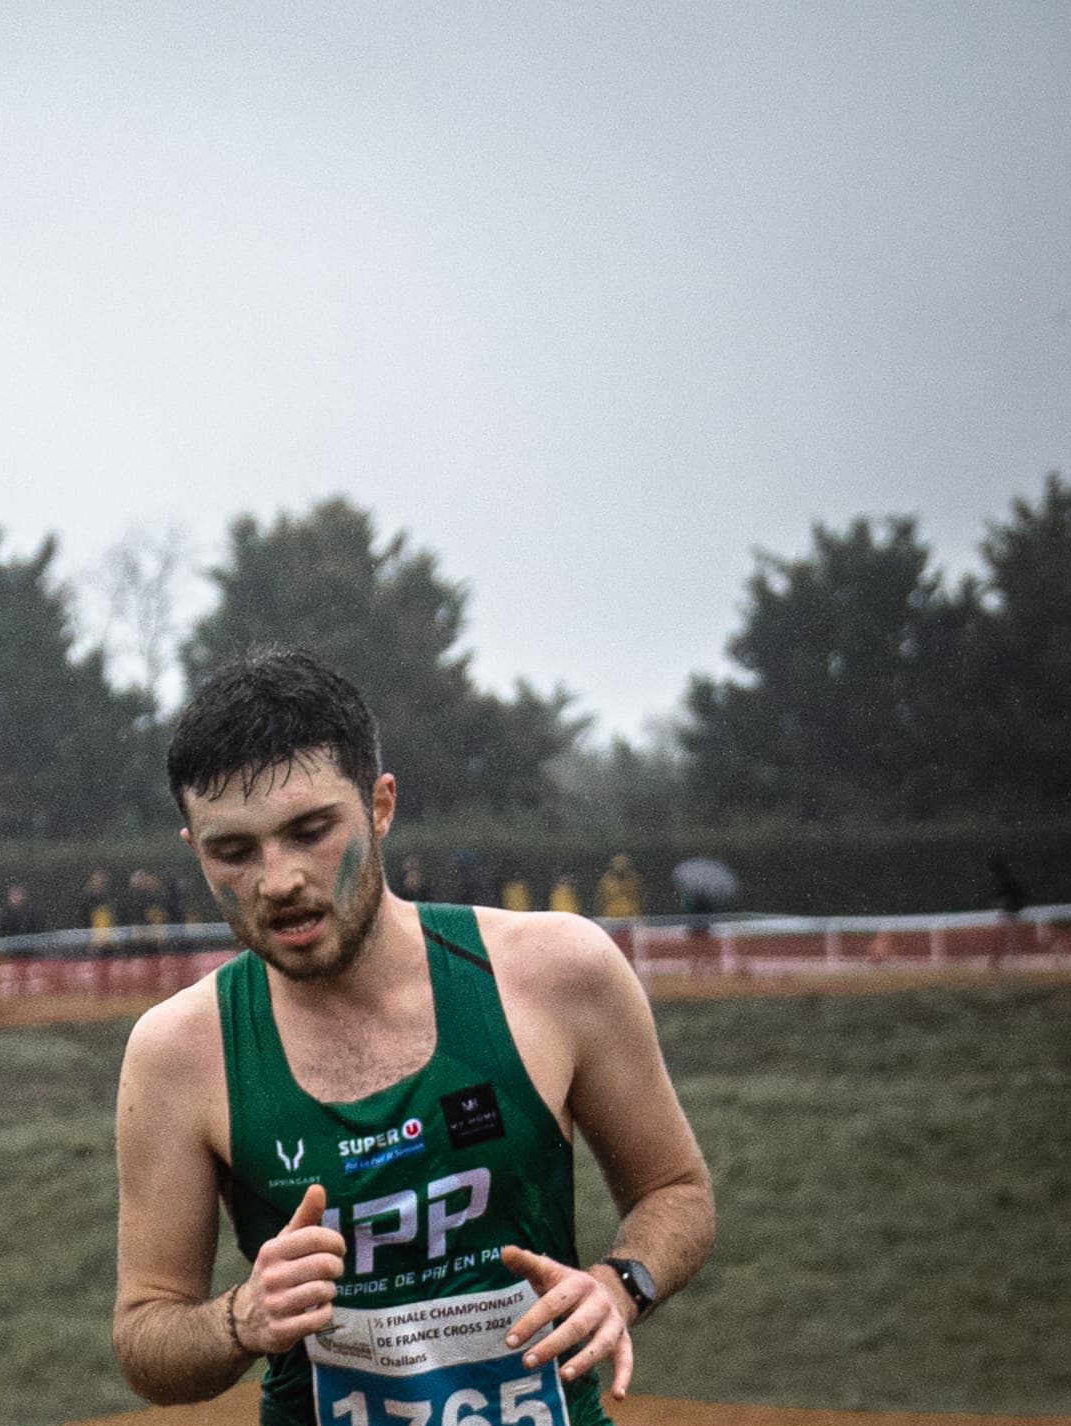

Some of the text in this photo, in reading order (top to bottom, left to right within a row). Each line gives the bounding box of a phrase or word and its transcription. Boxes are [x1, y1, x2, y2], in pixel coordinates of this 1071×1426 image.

[338, 1121, 420, 1157] SUPER U
[395, 1274, 416, 1288] DE
[454, 1254, 475, 1272] EN
[386, 1310, 427, 1329] FINALE
[429, 1291, 524, 1319] CHAMPIONNATS
[377, 1316, 512, 1348] DE FRANCE CROSS 2024
[380, 1353, 427, 1368] Challans
